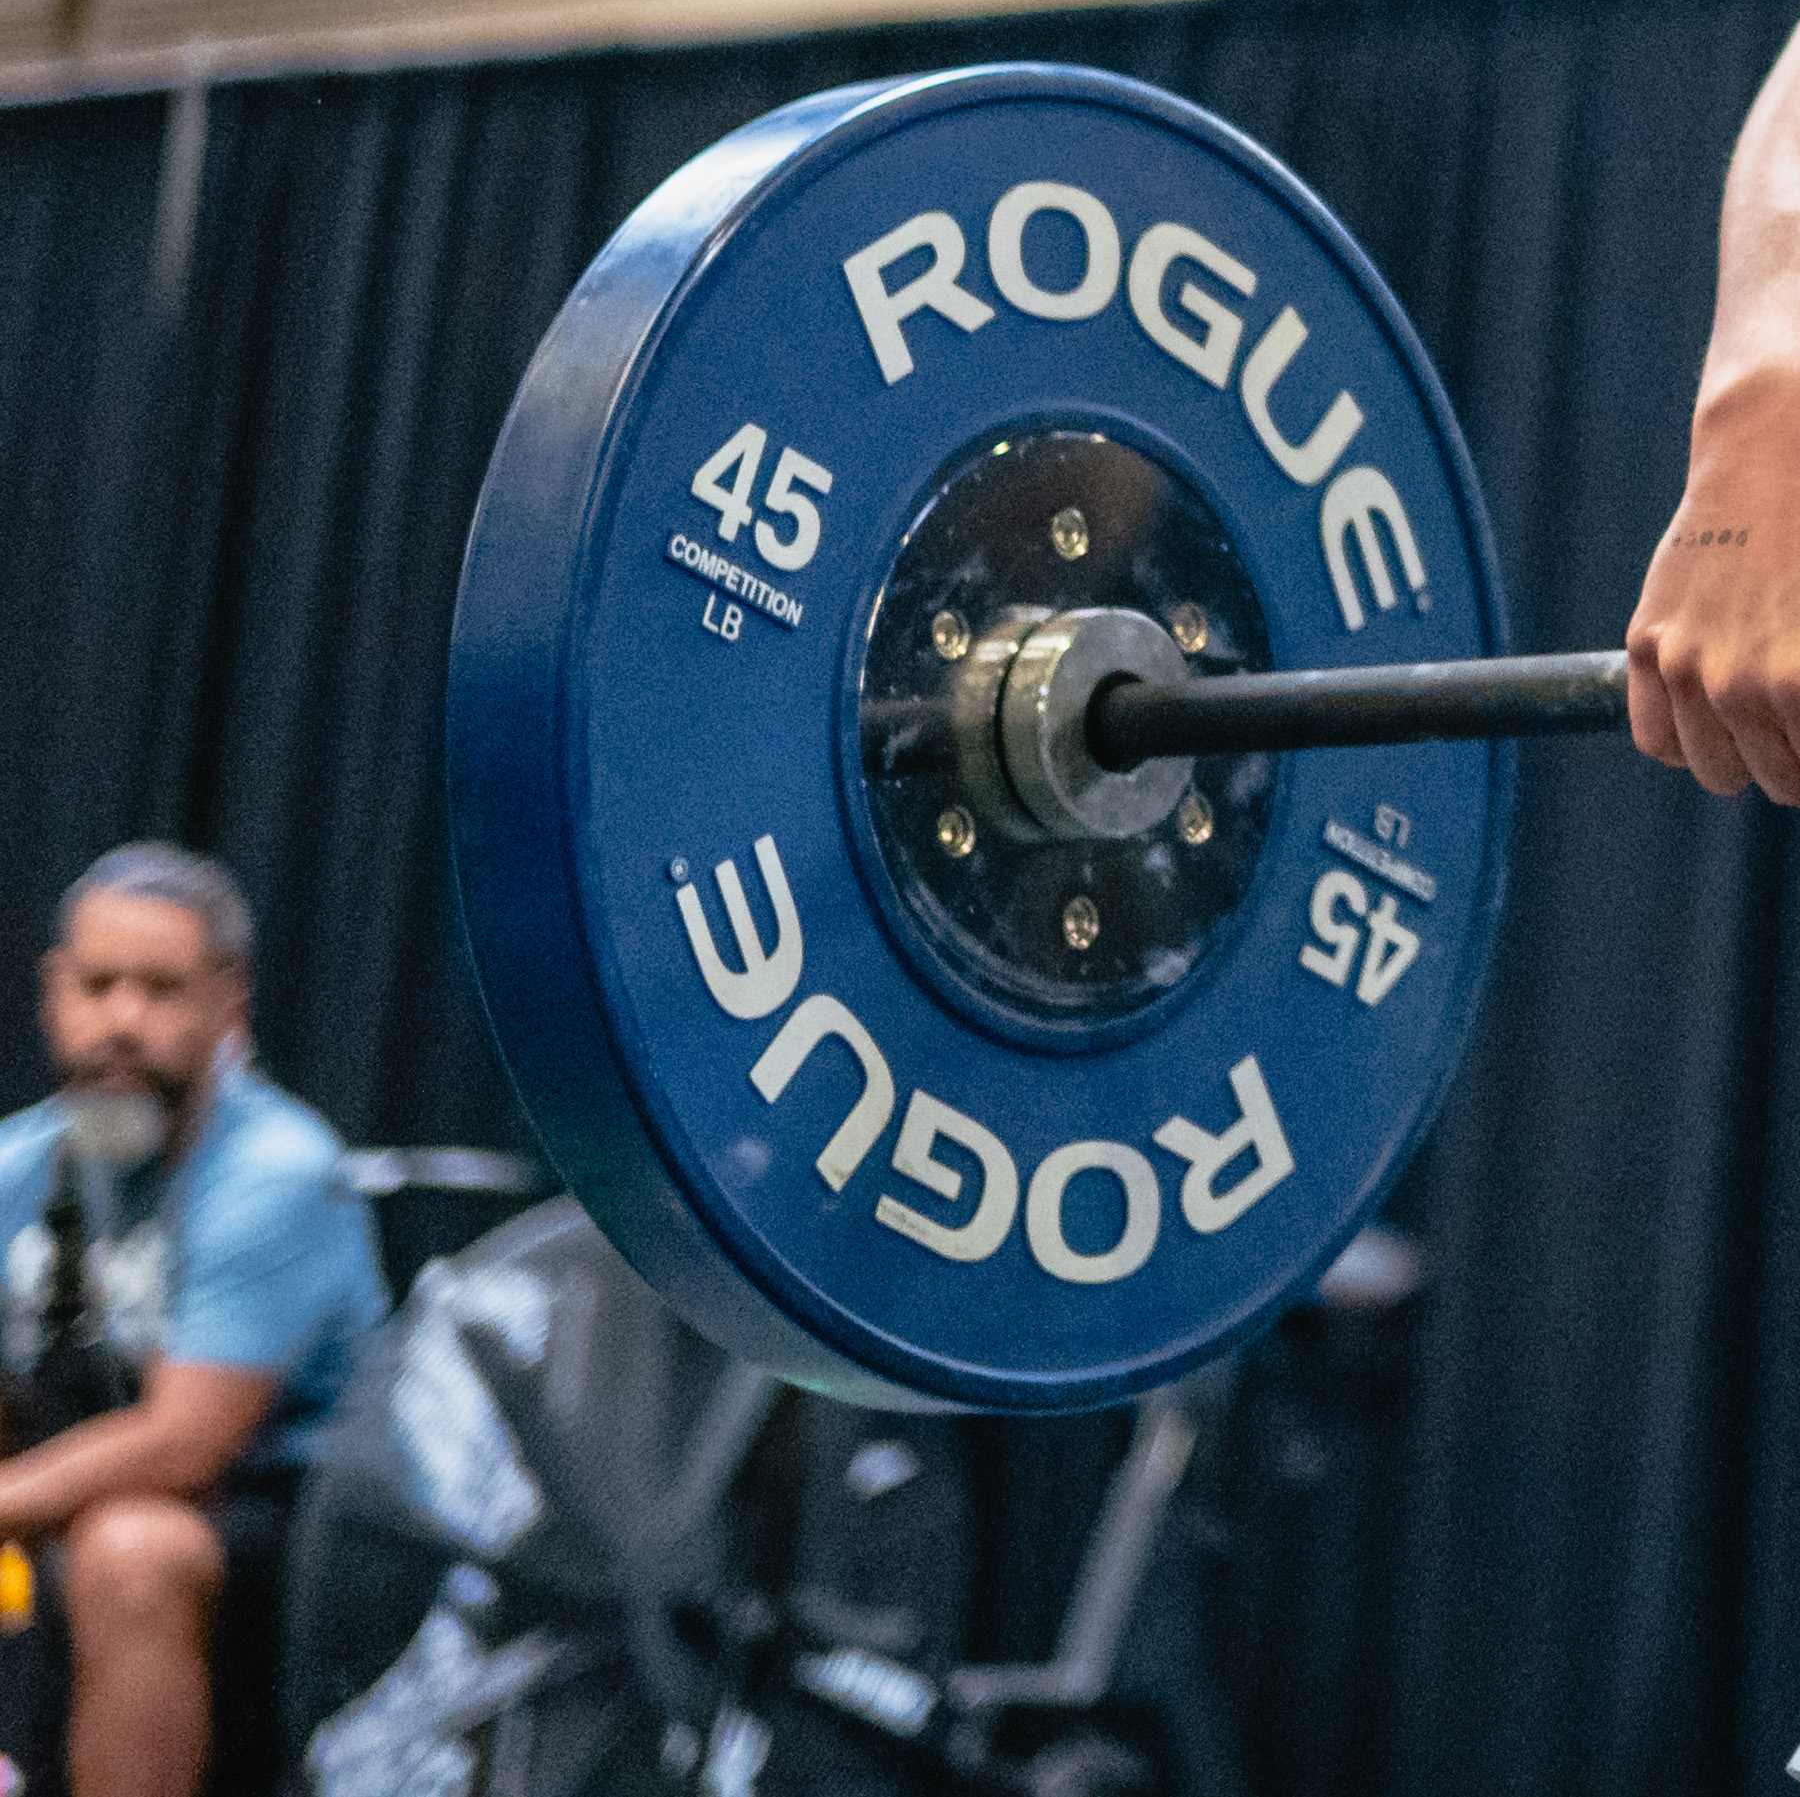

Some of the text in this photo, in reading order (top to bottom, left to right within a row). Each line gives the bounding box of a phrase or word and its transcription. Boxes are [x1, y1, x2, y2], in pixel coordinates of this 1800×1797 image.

[842, 179, 1428, 632] ROGUE
[691, 421, 834, 572] 45
[669, 533, 804, 627] COMPETITION
[702, 592, 744, 642] LB
[1299, 869, 1421, 1007] 45
[675, 834, 1294, 1284] ROGUE
